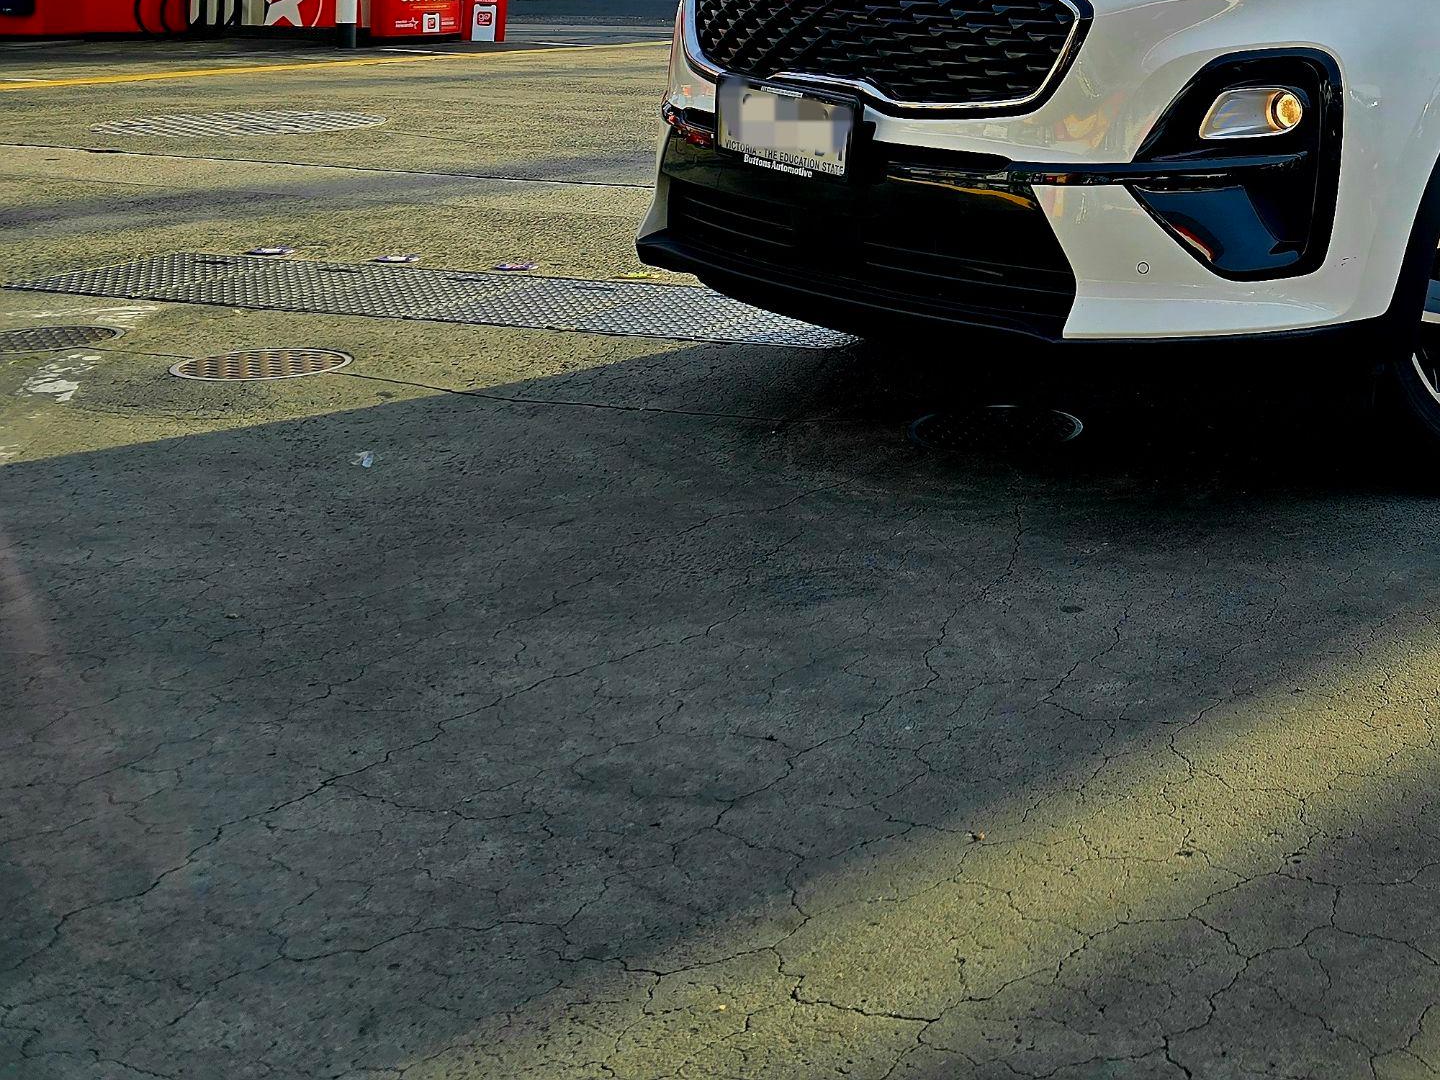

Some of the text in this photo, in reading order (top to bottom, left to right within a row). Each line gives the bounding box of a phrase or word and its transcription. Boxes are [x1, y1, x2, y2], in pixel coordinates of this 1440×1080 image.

[724, 139, 757, 156] VICTORIA
[763, 148, 778, 160] THE
[779, 151, 820, 170] EDUCATION
[821, 161, 845, 176] STATE
[743, 153, 813, 178] Buttons Automotive
